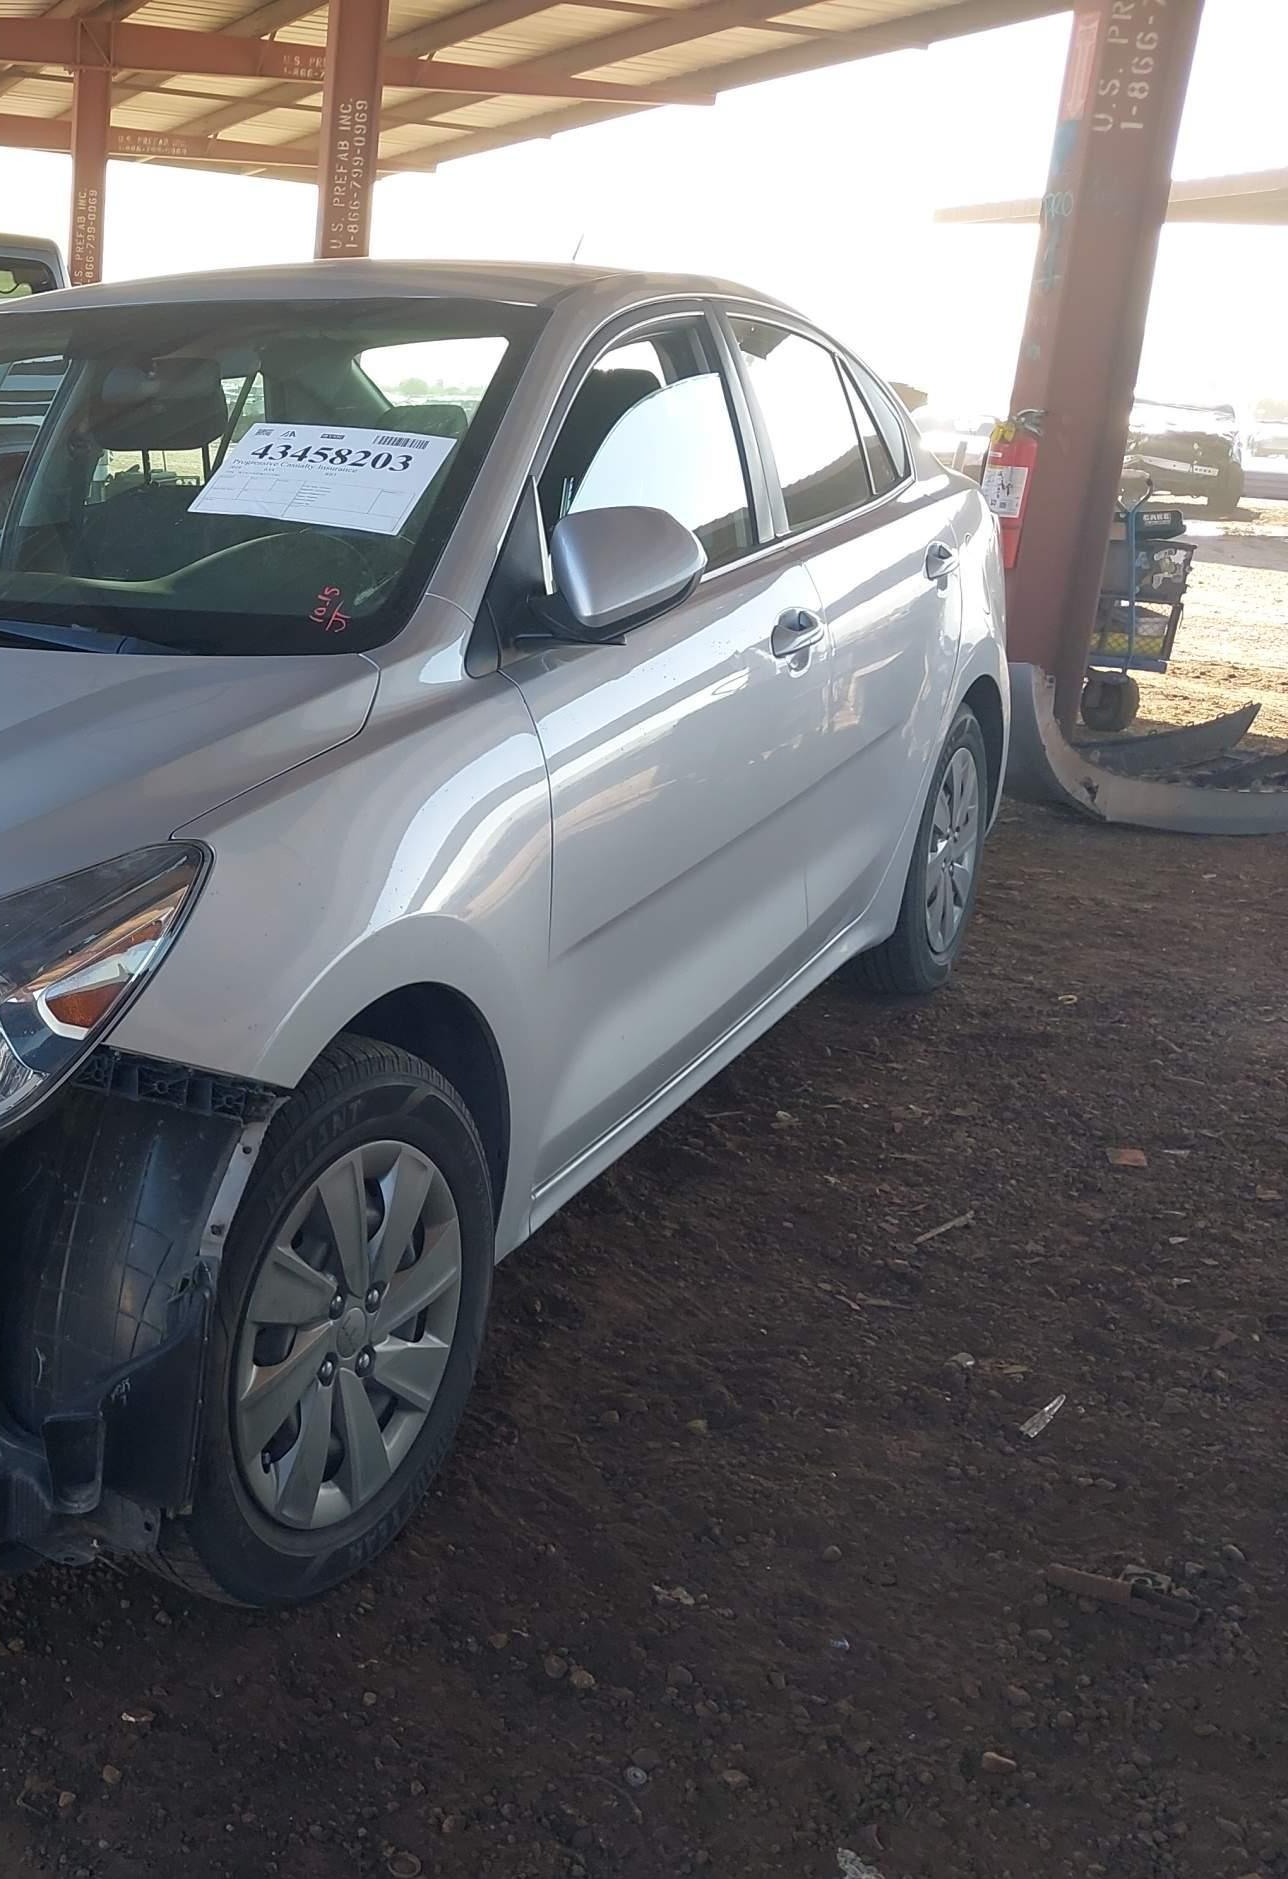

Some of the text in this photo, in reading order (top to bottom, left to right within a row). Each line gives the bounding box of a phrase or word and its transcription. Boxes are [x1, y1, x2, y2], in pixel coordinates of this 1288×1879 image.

[1092, 68, 1124, 132] U.S.
[332, 139, 351, 208] PREFAB
[345, 100, 369, 248] 1-866-799-0969
[232, 458, 279, 468] Progressive
[279, 460, 315, 471] Casualty
[316, 463, 359, 474] Insurance
[250, 443, 414, 473] 43458203
